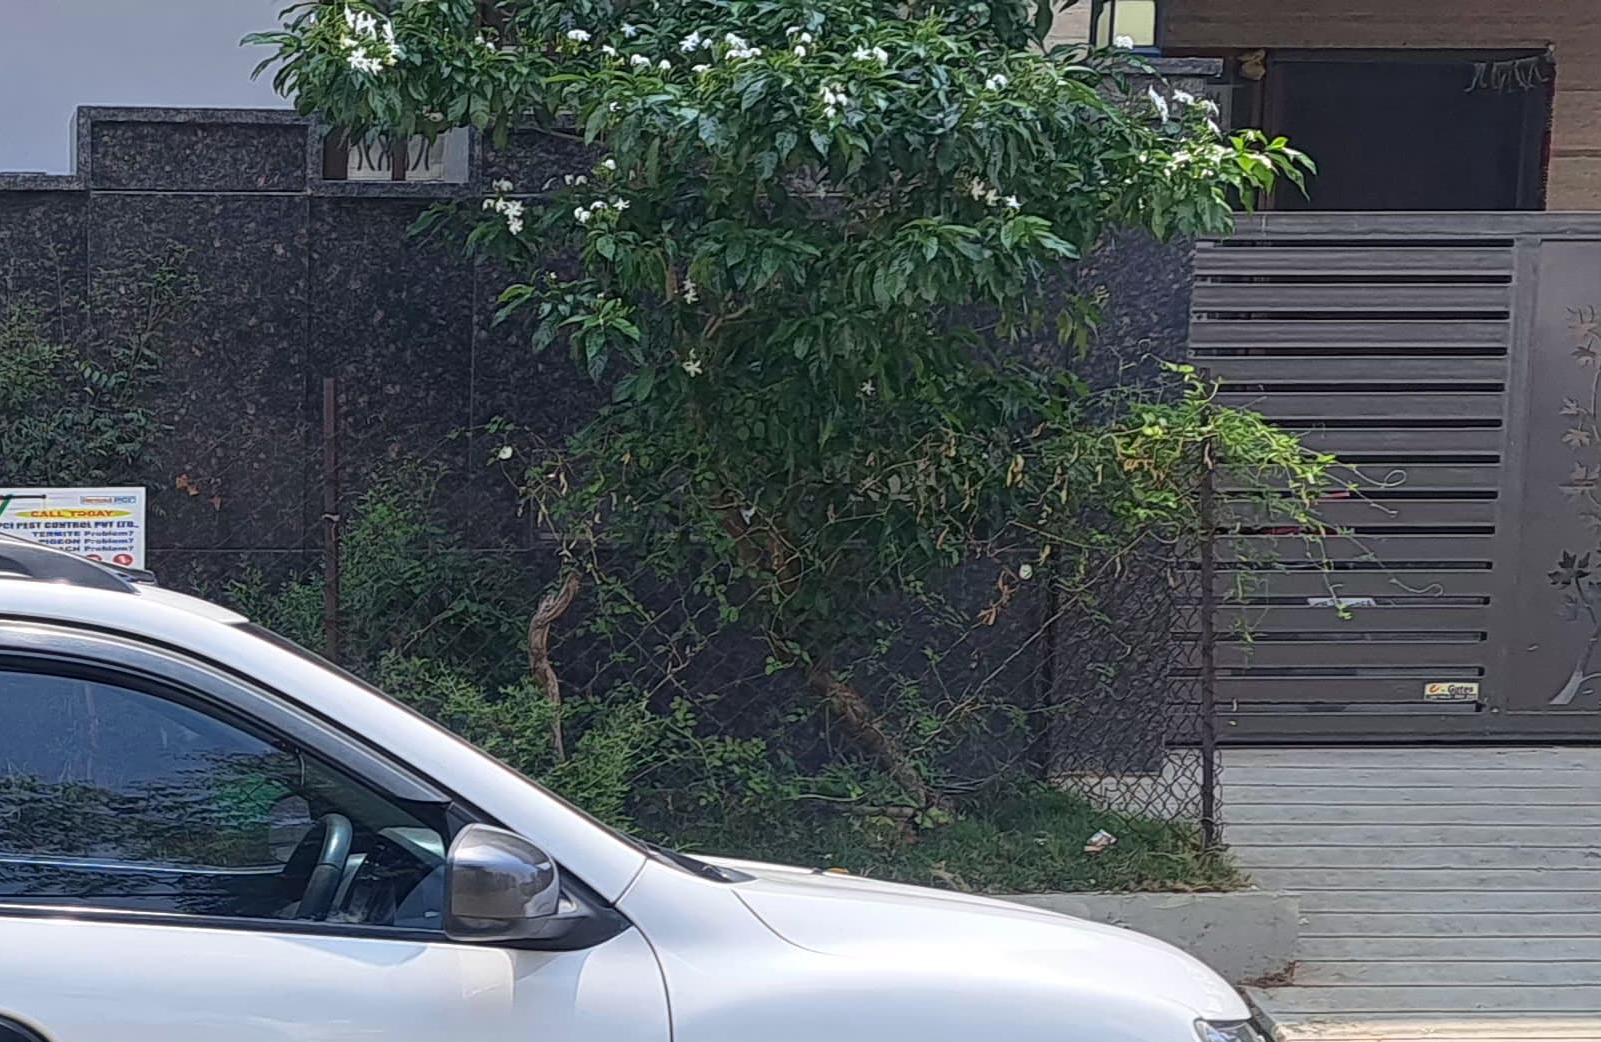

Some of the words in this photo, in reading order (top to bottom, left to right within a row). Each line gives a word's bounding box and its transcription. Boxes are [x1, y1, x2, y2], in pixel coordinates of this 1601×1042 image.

[30, 510, 64, 518] CALL
[44, 521, 91, 529] CONTROL
[31, 530, 80, 538] TERMITE
